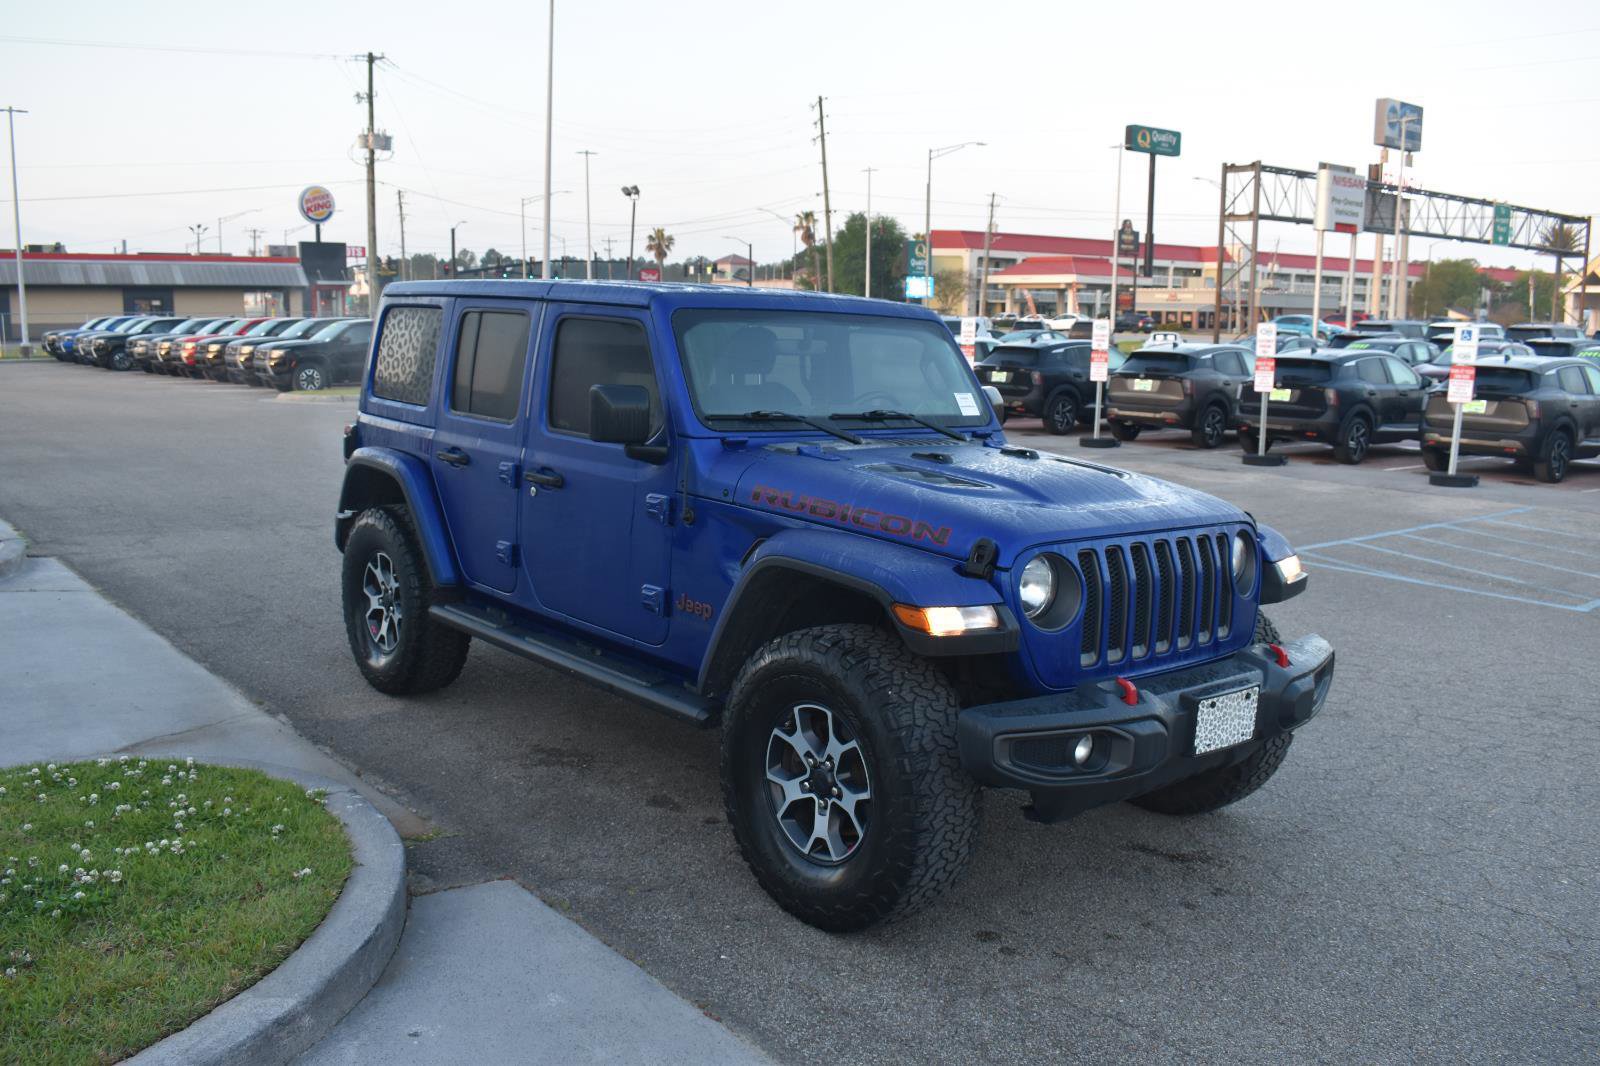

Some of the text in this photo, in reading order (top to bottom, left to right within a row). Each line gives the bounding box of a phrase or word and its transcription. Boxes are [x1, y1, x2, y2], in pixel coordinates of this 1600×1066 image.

[1152, 130, 1177, 146] Quality
[1333, 175, 1366, 189] NISSAN
[304, 193, 330, 205] BURGER
[306, 200, 332, 214] KING
[751, 484, 951, 546] RUBICON
[676, 592, 713, 621] Jeep
